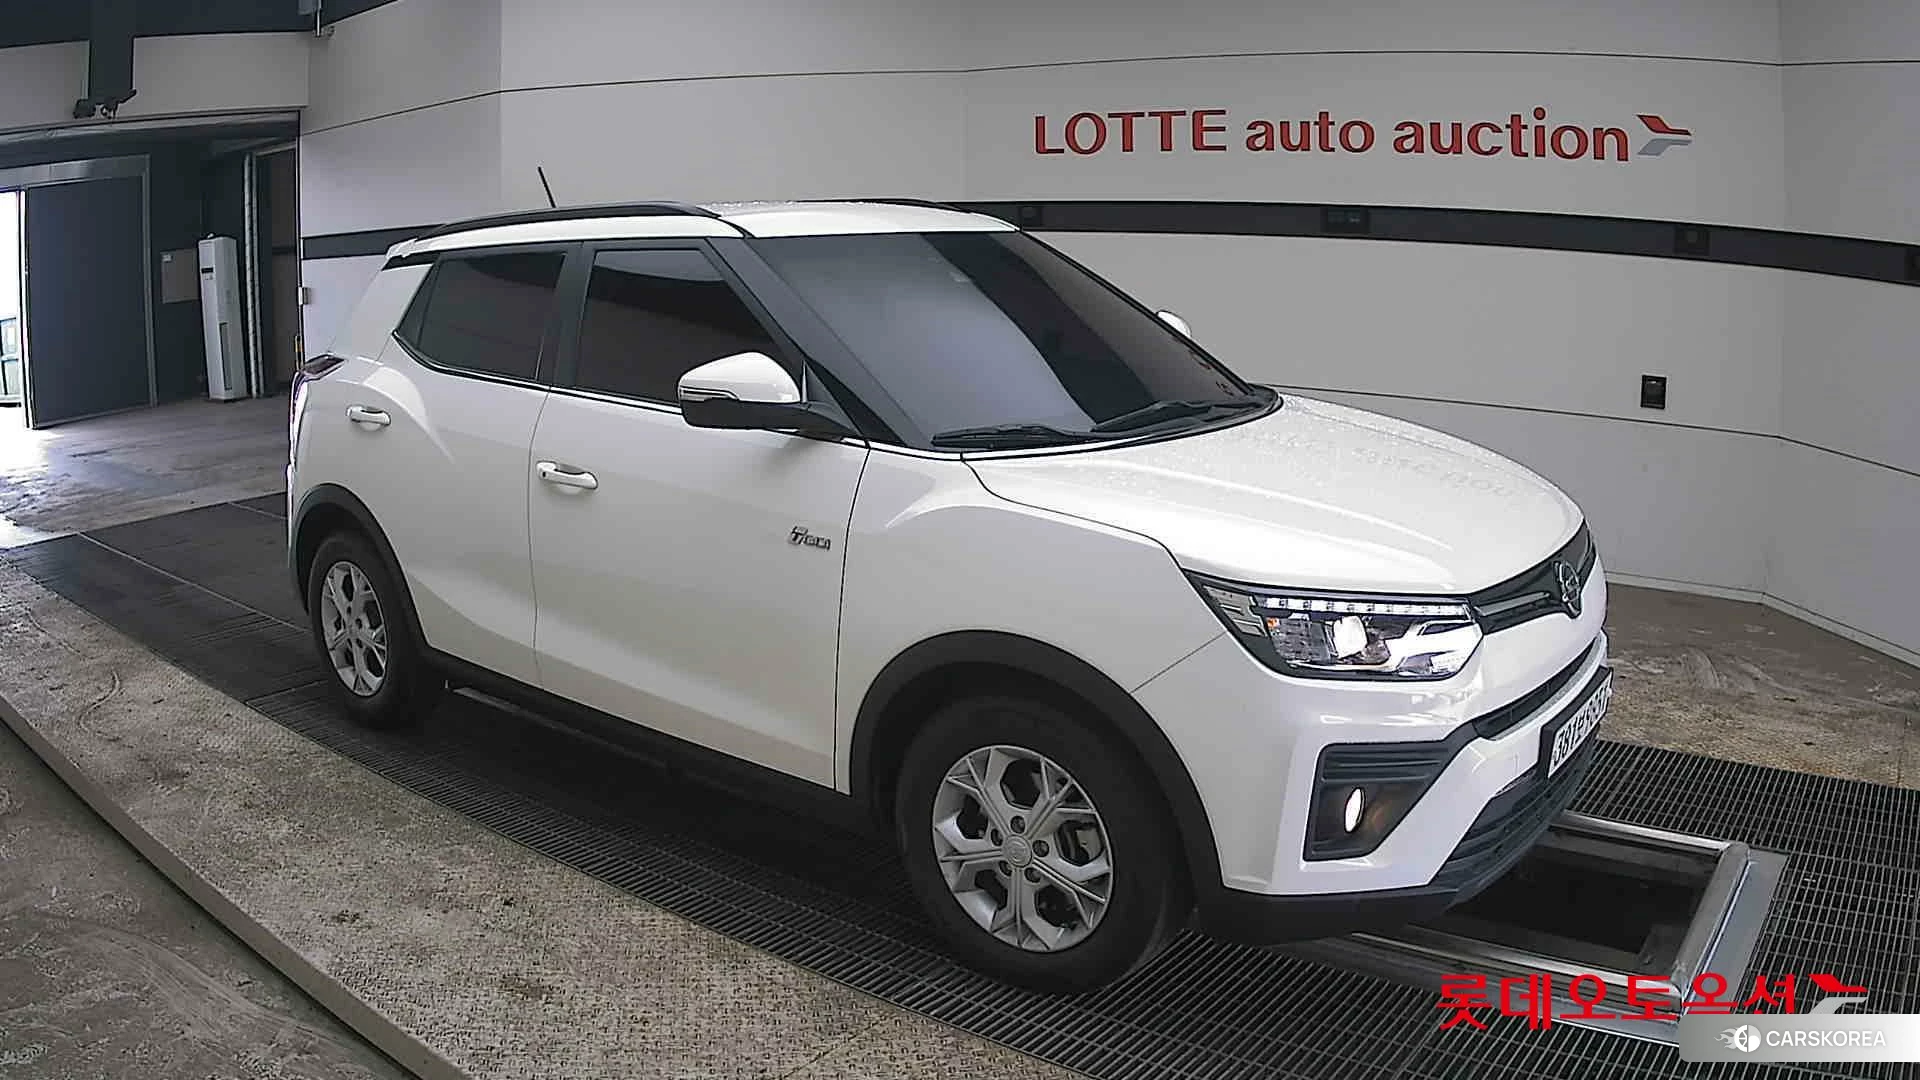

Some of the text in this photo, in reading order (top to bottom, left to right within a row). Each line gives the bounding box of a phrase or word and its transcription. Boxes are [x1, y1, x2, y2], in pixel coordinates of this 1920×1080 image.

[1035, 107, 1629, 162] LOTTE auto auction
